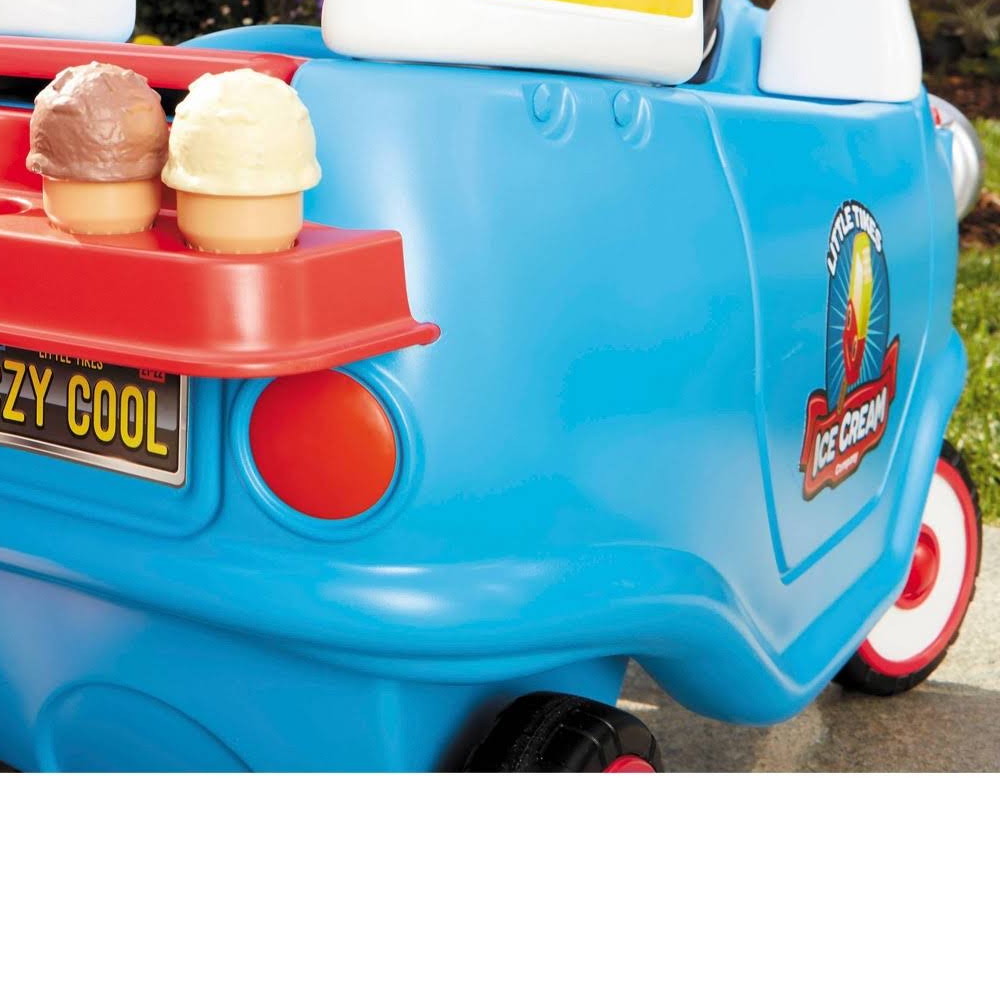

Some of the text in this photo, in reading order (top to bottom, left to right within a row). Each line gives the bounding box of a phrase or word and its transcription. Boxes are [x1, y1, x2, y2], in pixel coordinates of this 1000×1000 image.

[826, 204, 882, 276] LITTLE TIKES
[67, 373, 169, 457] COOL
[812, 386, 887, 478] ICE CREAM
